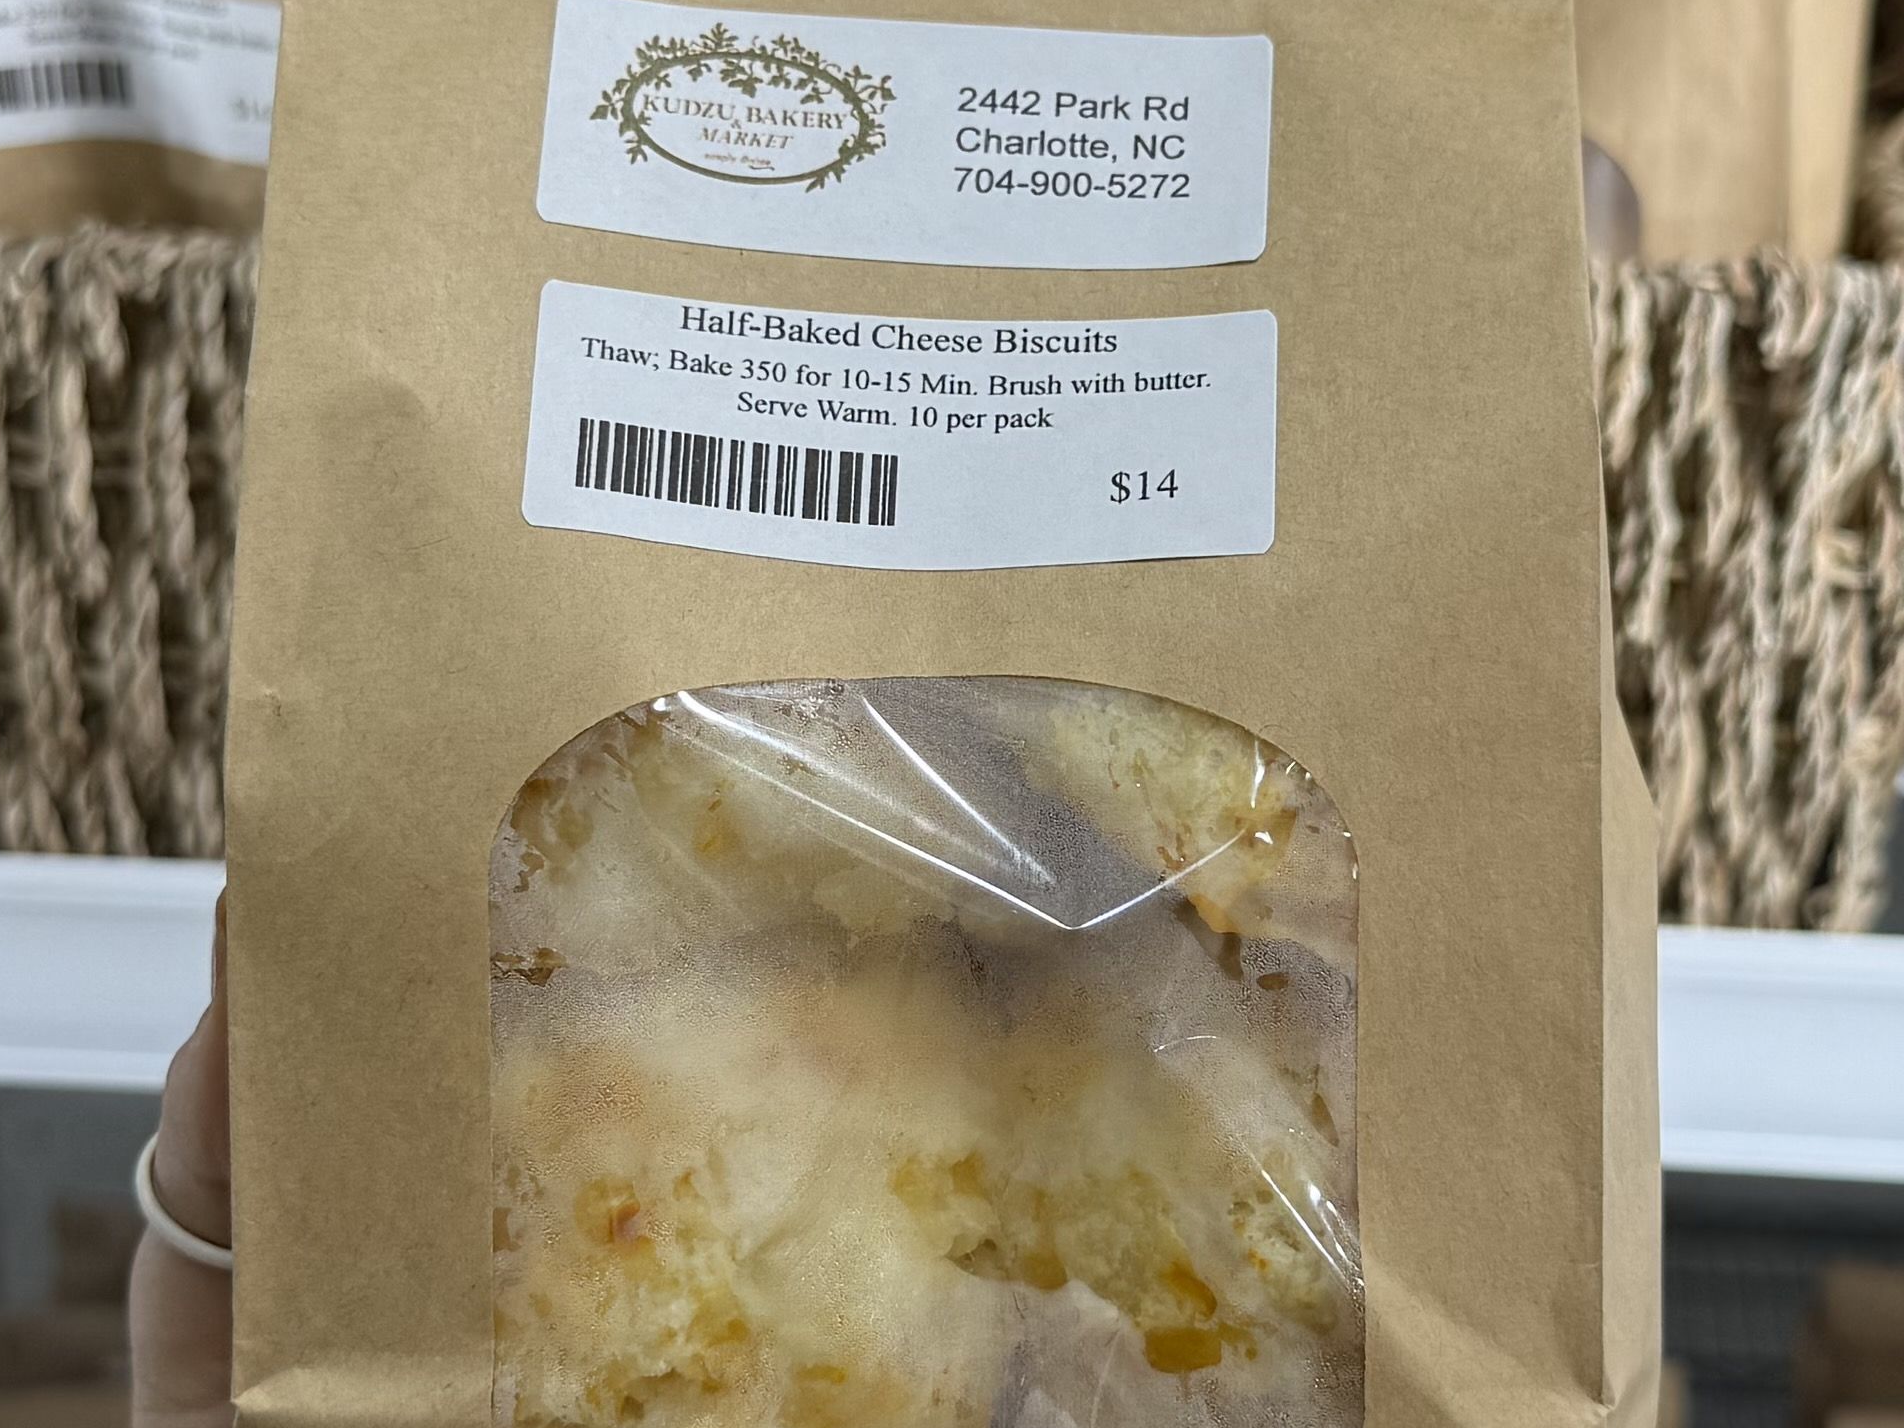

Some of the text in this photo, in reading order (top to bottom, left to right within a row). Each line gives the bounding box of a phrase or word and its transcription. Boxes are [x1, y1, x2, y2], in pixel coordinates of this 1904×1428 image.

[642, 94, 848, 131] KUDZU BAKERY
[957, 86, 1189, 122] 2442 Park Rd
[698, 127, 794, 150] MARKET
[955, 126, 1185, 164] Charlotte, NC
[954, 167, 1190, 199] 704-900-5272
[680, 305, 1118, 354] Half-Baked Cheese Biscuits
[580, 337, 1211, 396] Thaw; Bake 350 for 10-15 Min. Brush with butter.
[737, 391, 1053, 435] Serve Warm. 10 per pack
[1110, 468, 1179, 505] $14
